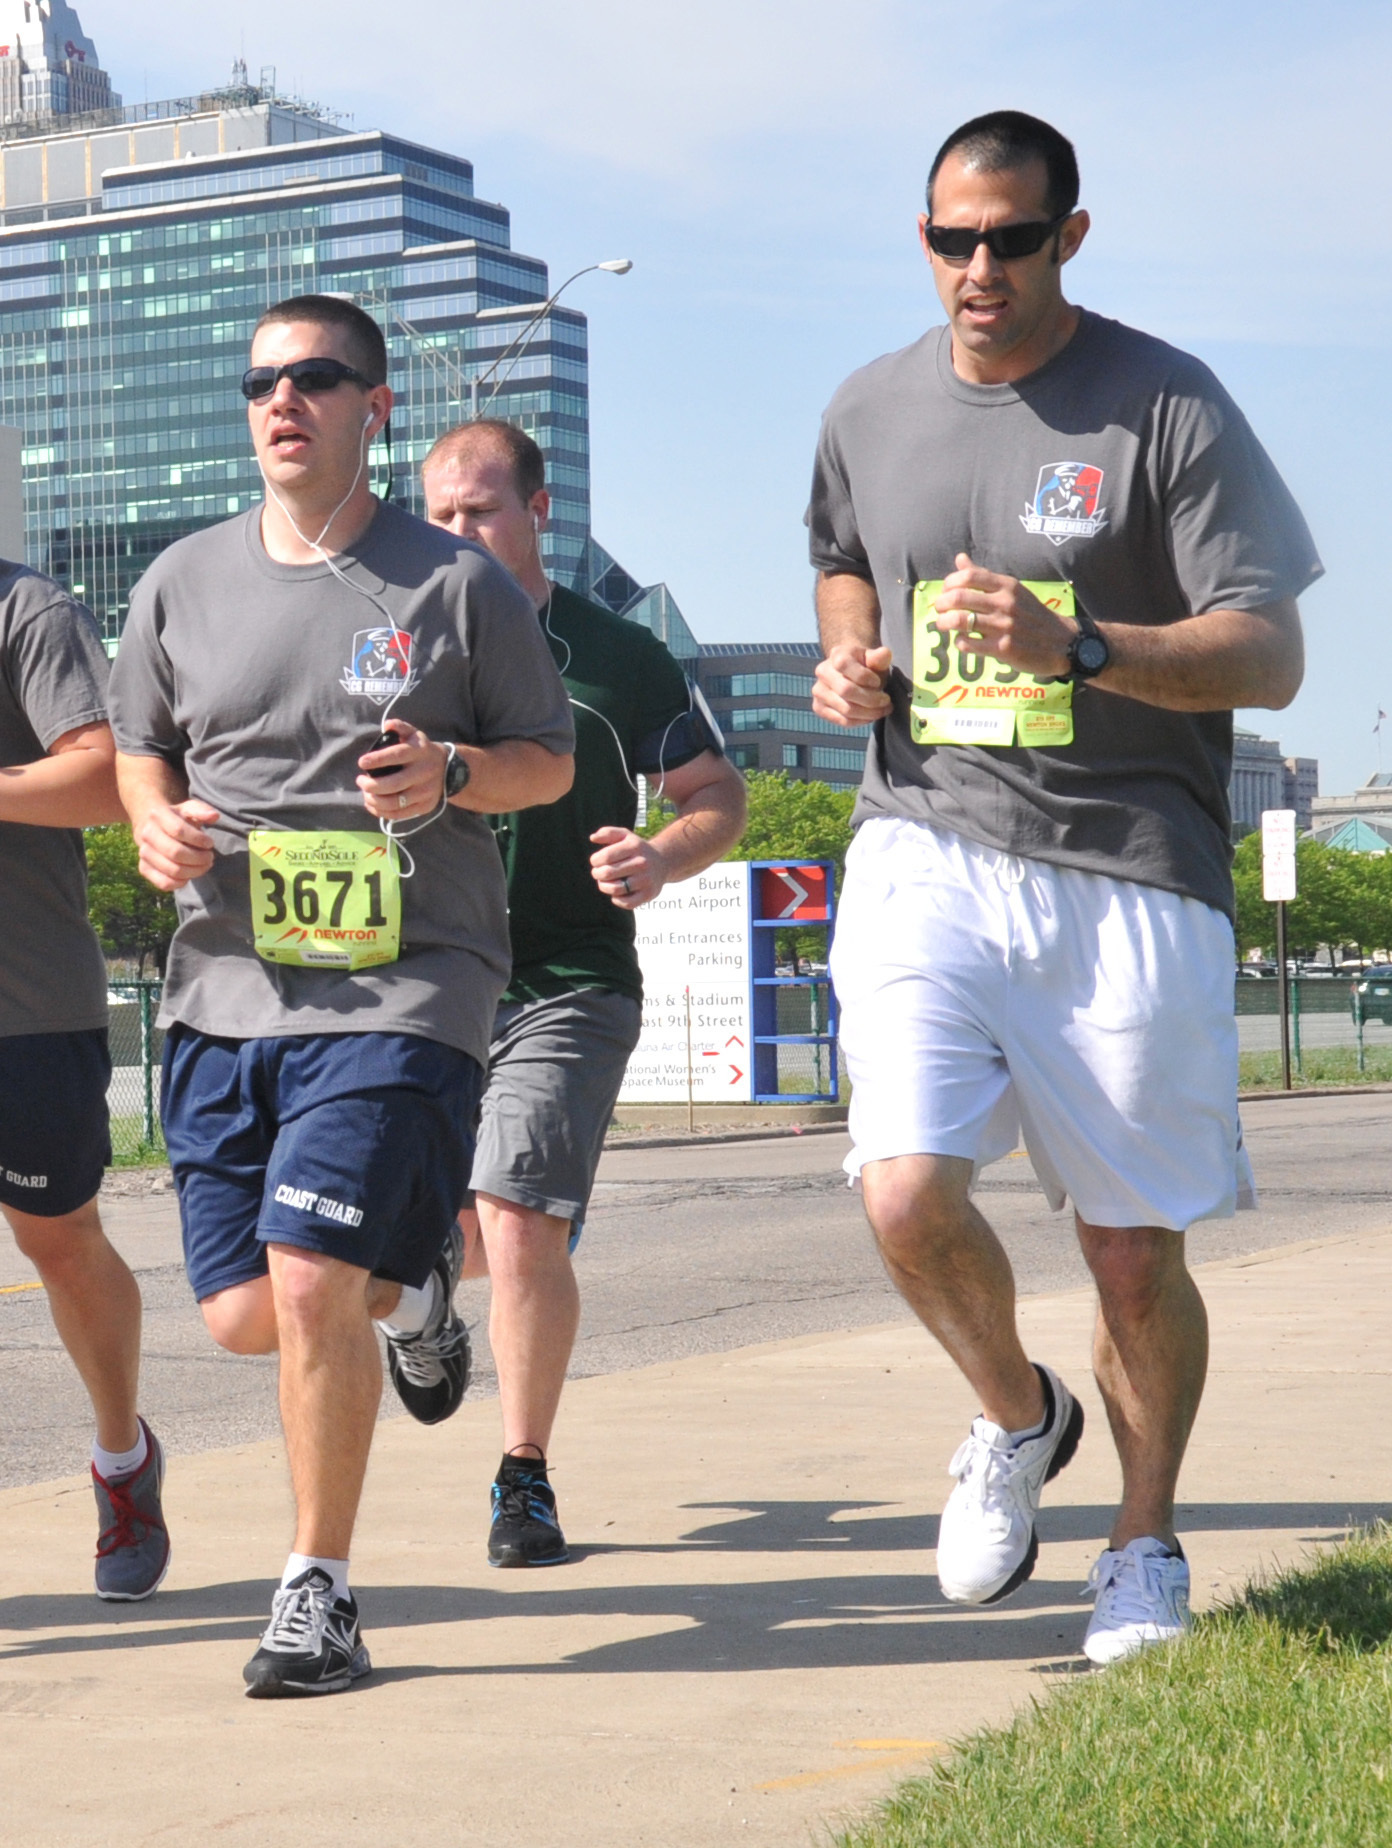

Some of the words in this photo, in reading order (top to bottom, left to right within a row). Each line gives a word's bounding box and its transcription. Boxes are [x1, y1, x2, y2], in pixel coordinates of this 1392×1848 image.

[975, 686, 1045, 699] NEWTON
[699, 877, 741, 890] Burke
[260, 868, 387, 928] 3671
[688, 895, 741, 912] Airport
[314, 929, 377, 940] NEWTON
[669, 931, 743, 944] Entrances
[688, 952, 743, 969] Parking
[666, 994, 675, 1006] &
[682, 993, 743, 1006] Stadium
[698, 1014, 743, 1027] Street
[678, 1041, 715, 1051] Carter
[6, 1170, 47, 1188] GUARD
[274, 1184, 318, 1211] COAST
[315, 1197, 364, 1228] GUARD
